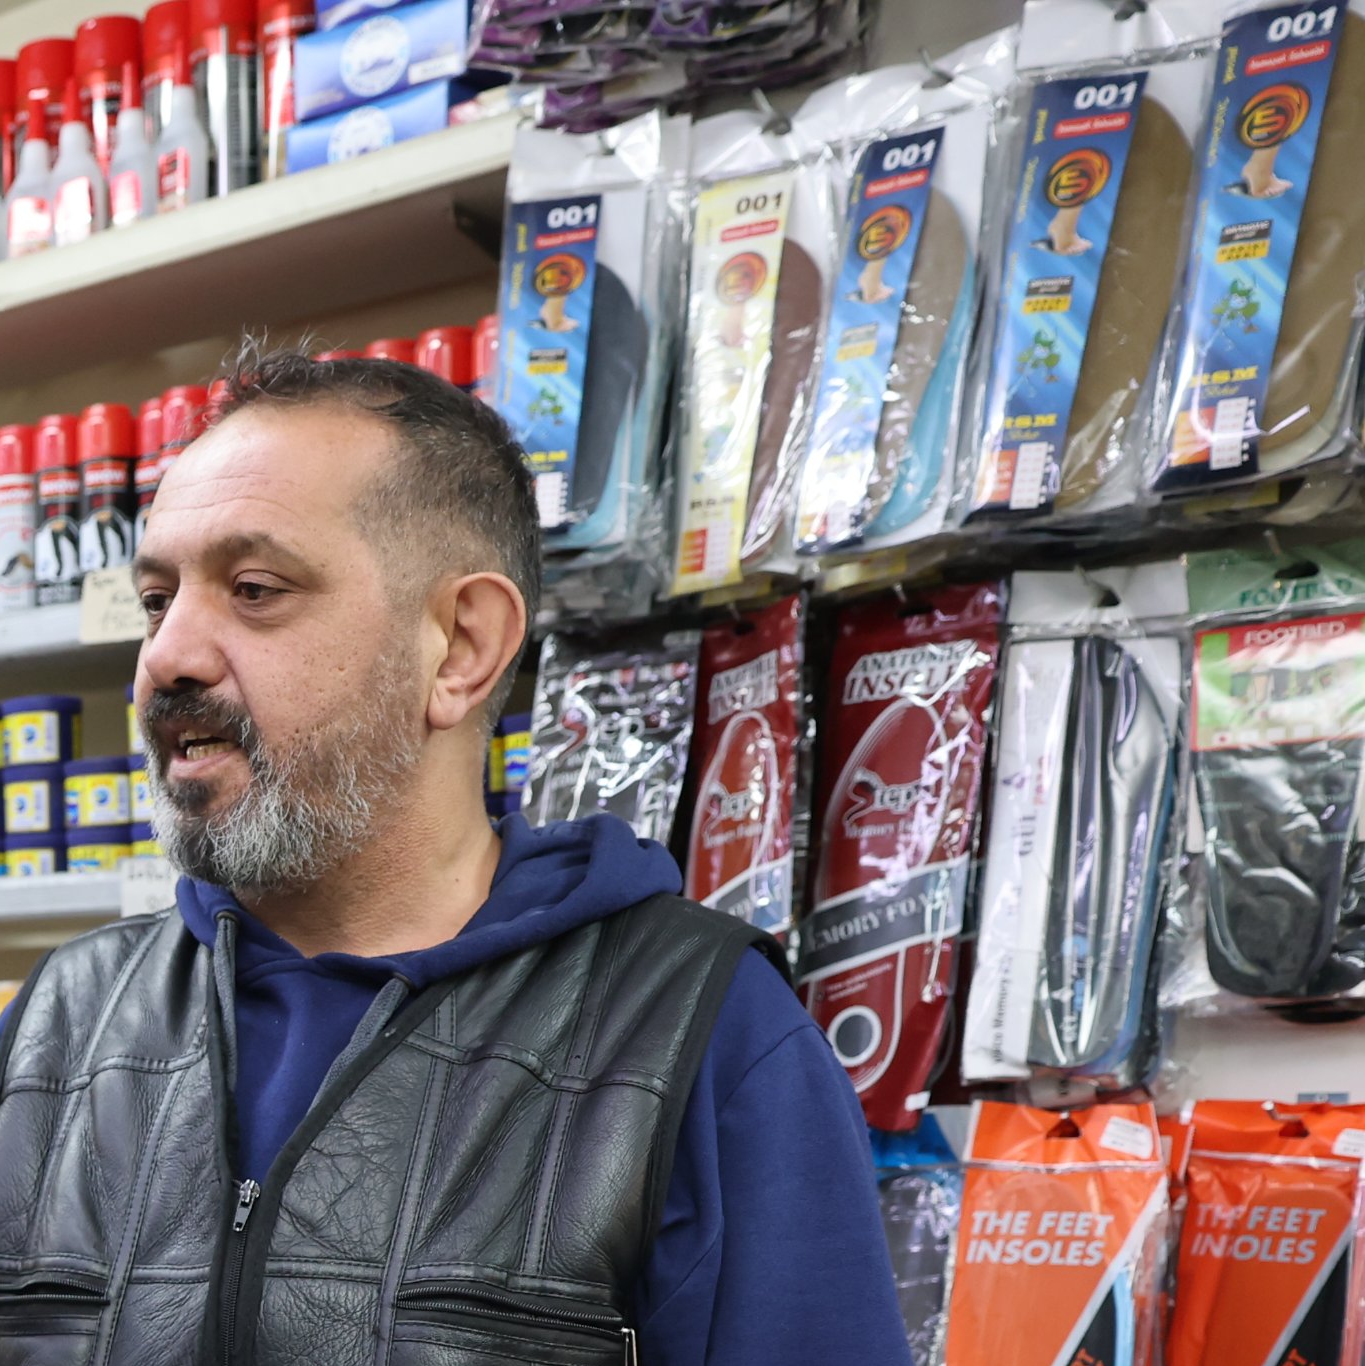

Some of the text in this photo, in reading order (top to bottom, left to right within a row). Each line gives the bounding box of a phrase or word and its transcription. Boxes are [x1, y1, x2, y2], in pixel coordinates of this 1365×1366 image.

[1267, 6, 1338, 42] 001
[1074, 81, 1138, 110] 001
[883, 139, 936, 171] 001
[547, 203, 597, 228] 001
[736, 192, 782, 215] 001
[971, 1210, 1114, 1237] THE FEET
[1247, 1205, 1327, 1233] FEET
[965, 1238, 1105, 1267] INSOLES
